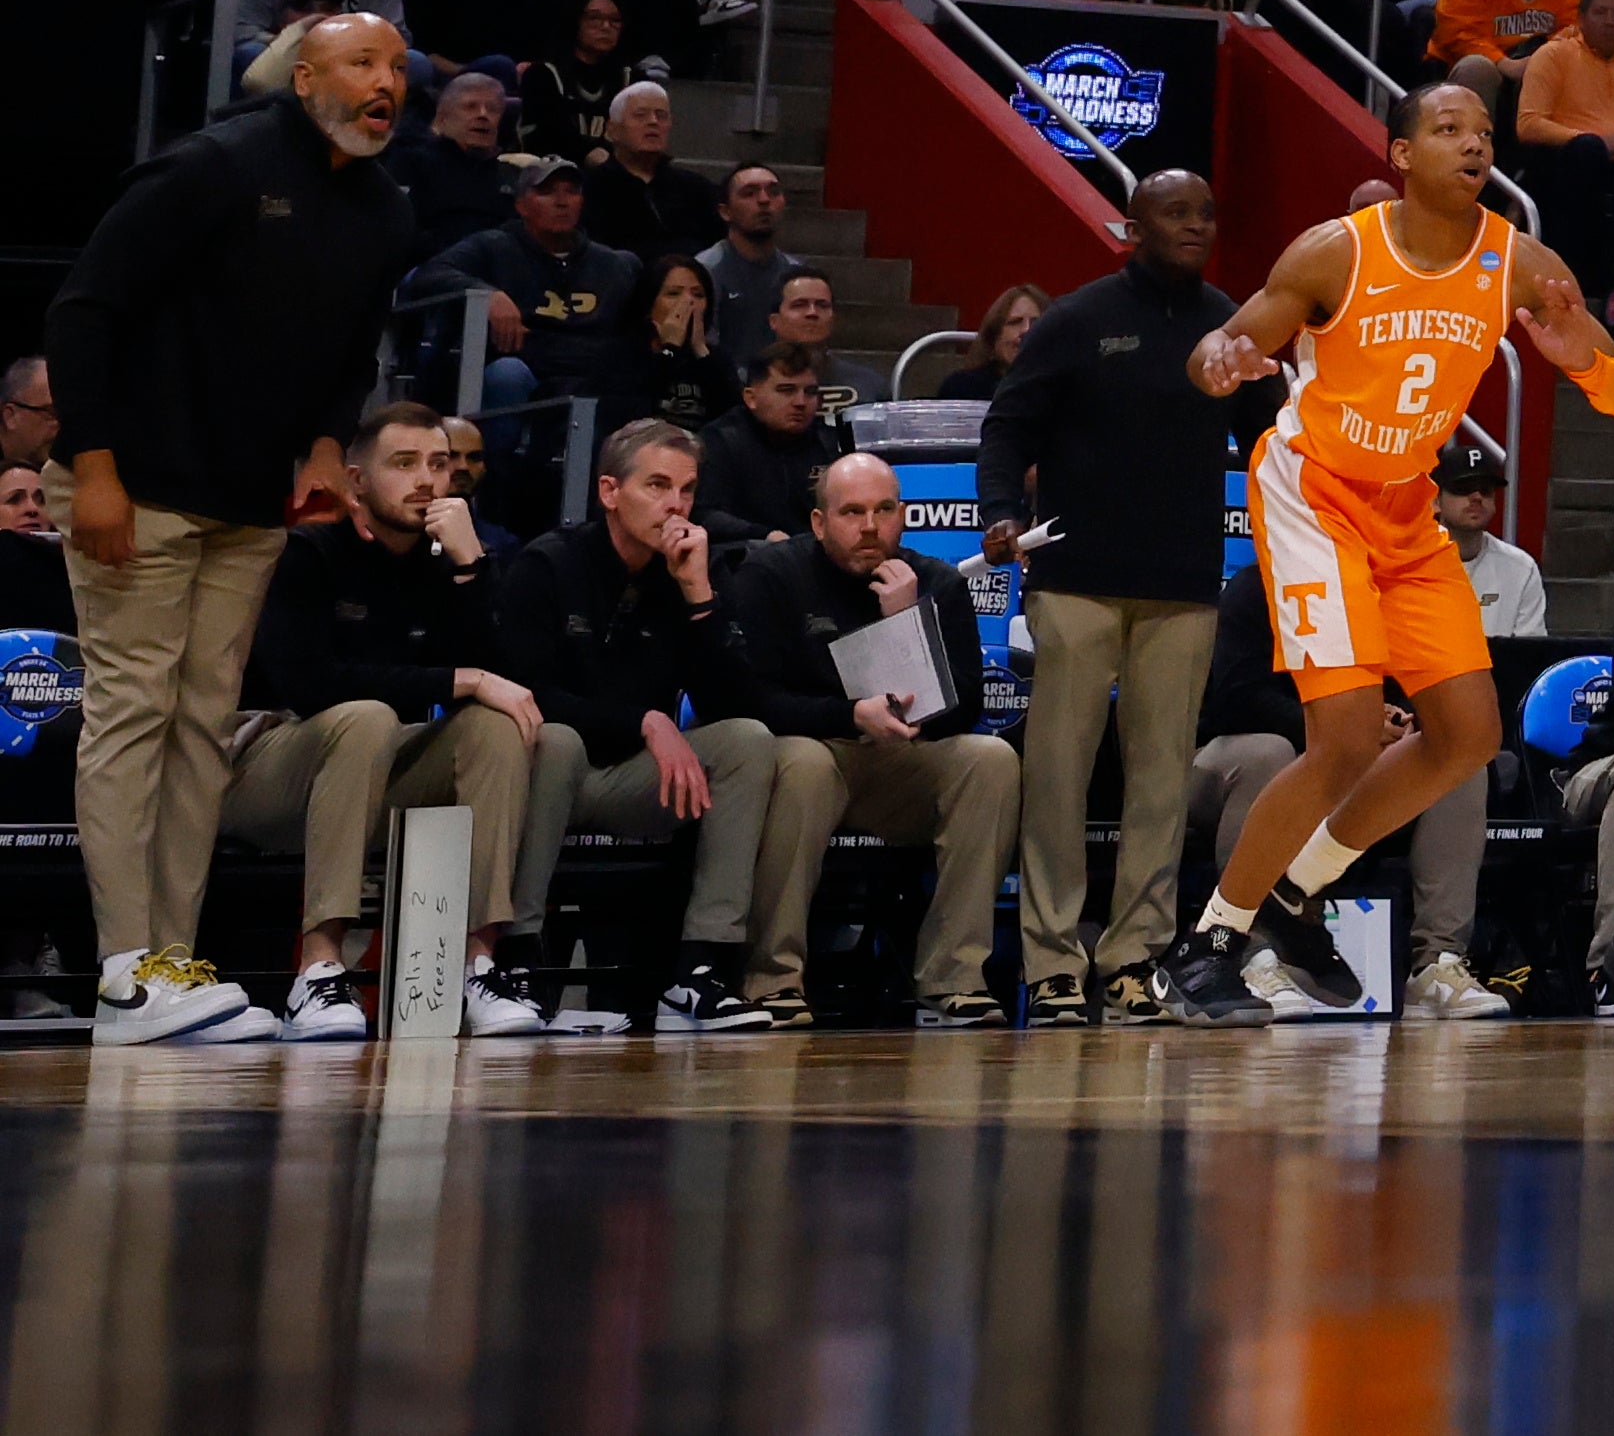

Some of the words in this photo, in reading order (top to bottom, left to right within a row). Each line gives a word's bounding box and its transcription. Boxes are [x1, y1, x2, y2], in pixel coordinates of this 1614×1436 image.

[1047, 72, 1121, 99] MARCH
[1358, 309, 1488, 353] TENNESSEE
[1395, 353, 1436, 415] 2
[1282, 583, 1327, 636] T
[6, 672, 60, 686] MARCH
[15, 834, 48, 846] ROAD
[49, 834, 63, 846] TO
[839, 836, 858, 848] THE
[1497, 827, 1520, 839] FINAL
[1520, 827, 1544, 839] FOUR
